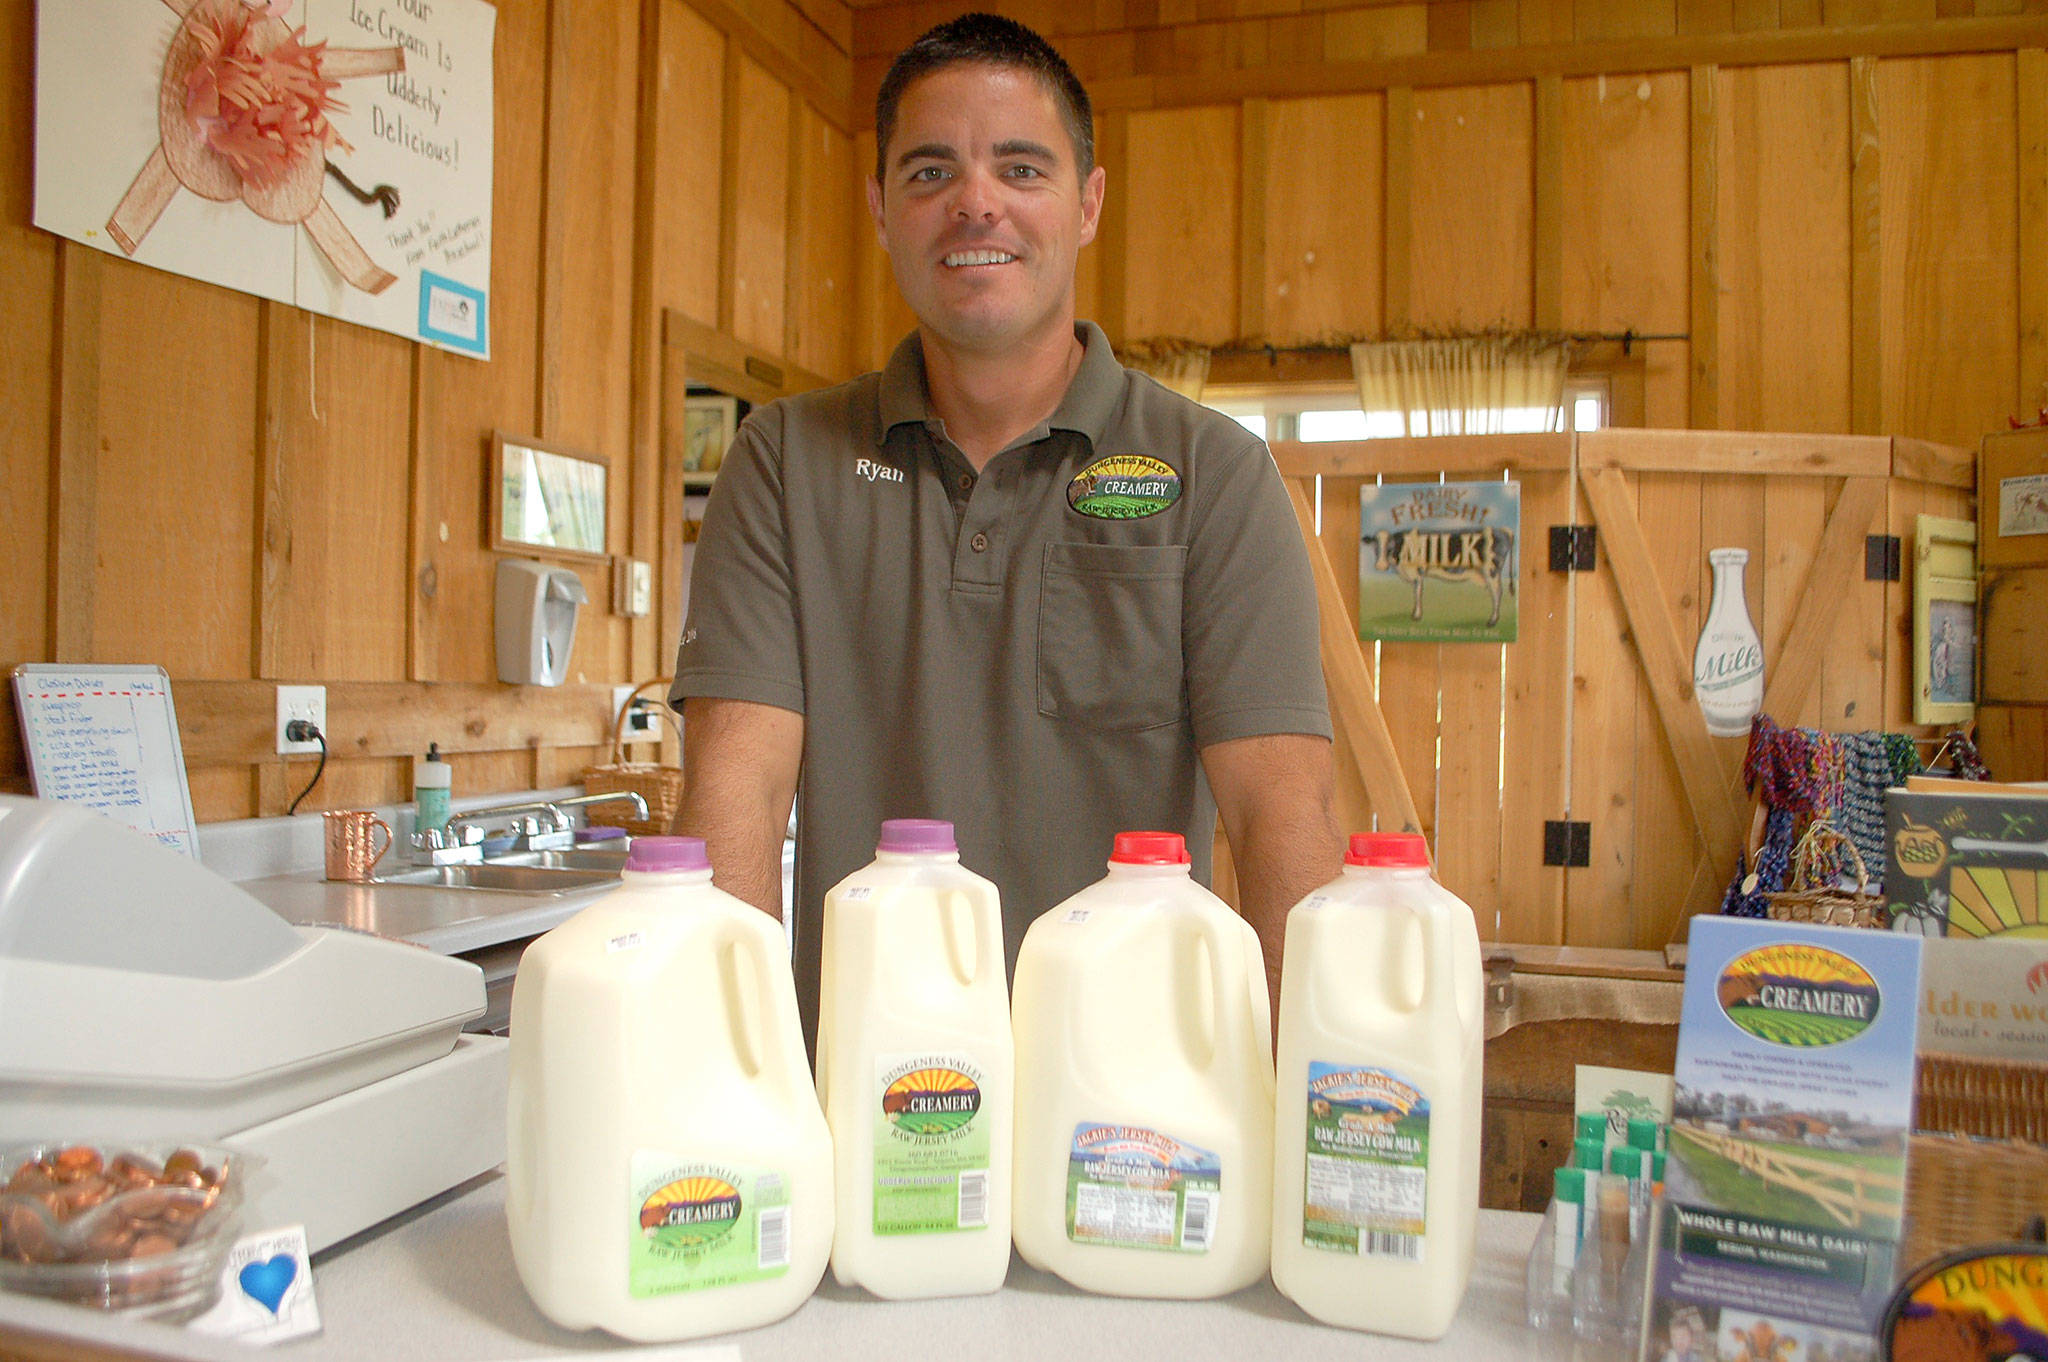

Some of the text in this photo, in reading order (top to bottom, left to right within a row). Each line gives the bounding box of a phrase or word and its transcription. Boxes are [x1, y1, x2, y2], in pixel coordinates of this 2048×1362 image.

[396, 0, 432, 23] our
[350, 0, 452, 71] Ice Cream Is
[387, 72, 441, 125] Udderly
[373, 104, 460, 171] Delicious!
[856, 459, 904, 483] Ryan
[1085, 458, 1169, 477] DUNGENESS VALLEY
[1104, 481, 1168, 497] CREAMERY
[1412, 487, 1468, 502] DAIRY
[1400, 532, 1484, 570] MILK
[1695, 644, 1760, 682] Milk
[1761, 984, 1869, 1018] CREAMERY
[882, 1055, 984, 1086] DUNGENESS VALLEY
[911, 1094, 975, 1113] CREAMERY
[891, 1123, 975, 1146] RAW JERSEY MILK
[1076, 1127, 1116, 1149] JACKIE'S
[1119, 1127, 1155, 1145] JERSEY
[1314, 1125, 1421, 1153] RAW JERSEY COW MILK
[708, 1163, 744, 1188] VALLEY
[1101, 1162, 1132, 1177] JERSEY
[1149, 1166, 1170, 1180] MILK
[669, 1200, 737, 1226] CREAMERY
[1679, 1210, 1735, 1234] WHOLE
[1739, 1222, 1775, 1241] RAW
[1780, 1229, 1818, 1248] MILK
